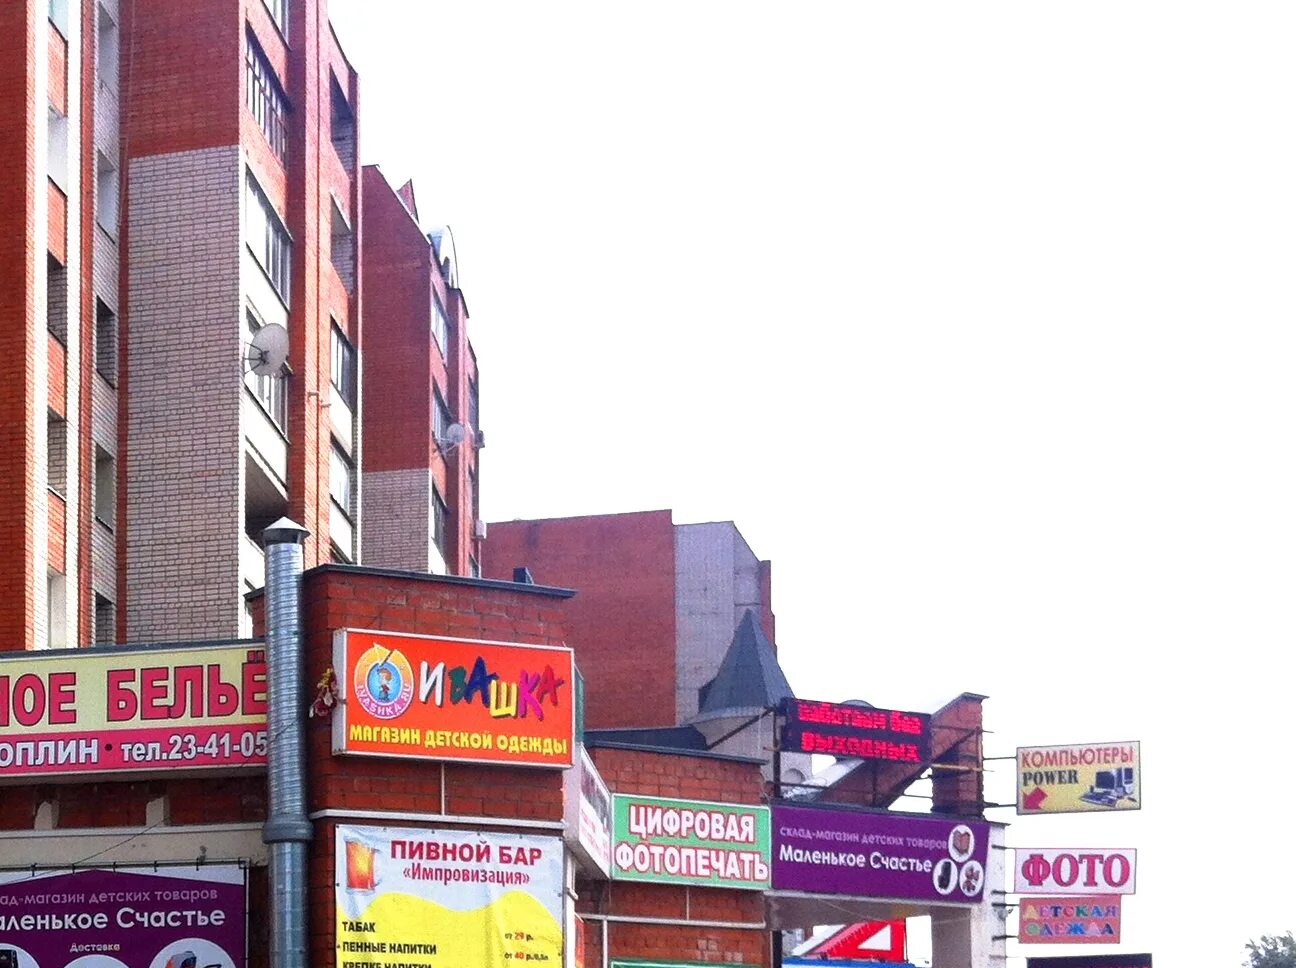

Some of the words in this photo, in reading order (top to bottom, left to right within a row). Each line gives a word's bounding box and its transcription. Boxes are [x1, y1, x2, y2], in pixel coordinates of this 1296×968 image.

[106, 650, 266, 722] БЕЛЬЁ
[418, 656, 565, 722] ИВАШКА
[349, 724, 420, 745] МАГАЗИН
[424, 730, 493, 749] ДЕТСКОЙ
[497, 736, 568, 755] ОДЕЖДЫ
[1022, 747, 1134, 767] КОМПЬЮТЕРЫ
[1023, 769, 1079, 786] POWER
[629, 804, 755, 843] ЦИФРОВАЯ
[779, 826, 859, 843] склад-магазин
[861, 832, 904, 846] детских
[906, 837, 947, 851] товаров
[390, 839, 491, 864] ПИВНОЙ
[498, 845, 542, 866] БАР
[615, 842, 769, 880] ФОТОПЕЧАТЬ
[779, 844, 866, 868] Маленькое
[869, 852, 932, 874] Счастье
[403, 862, 530, 887] «Импровизация»
[1021, 853, 1131, 887] ФОТО
[88, 891, 151, 905] детских
[154, 888, 218, 903] товаров
[116, 907, 226, 929] Счастье
[1023, 904, 1120, 920] ДЕТСКАЯ
[342, 921, 376, 932] ТАБАК
[69, 943, 120, 953] Доставка
[342, 941, 386, 953] ПЕННЫЕ
[389, 943, 437, 954] НАПИТКИ
